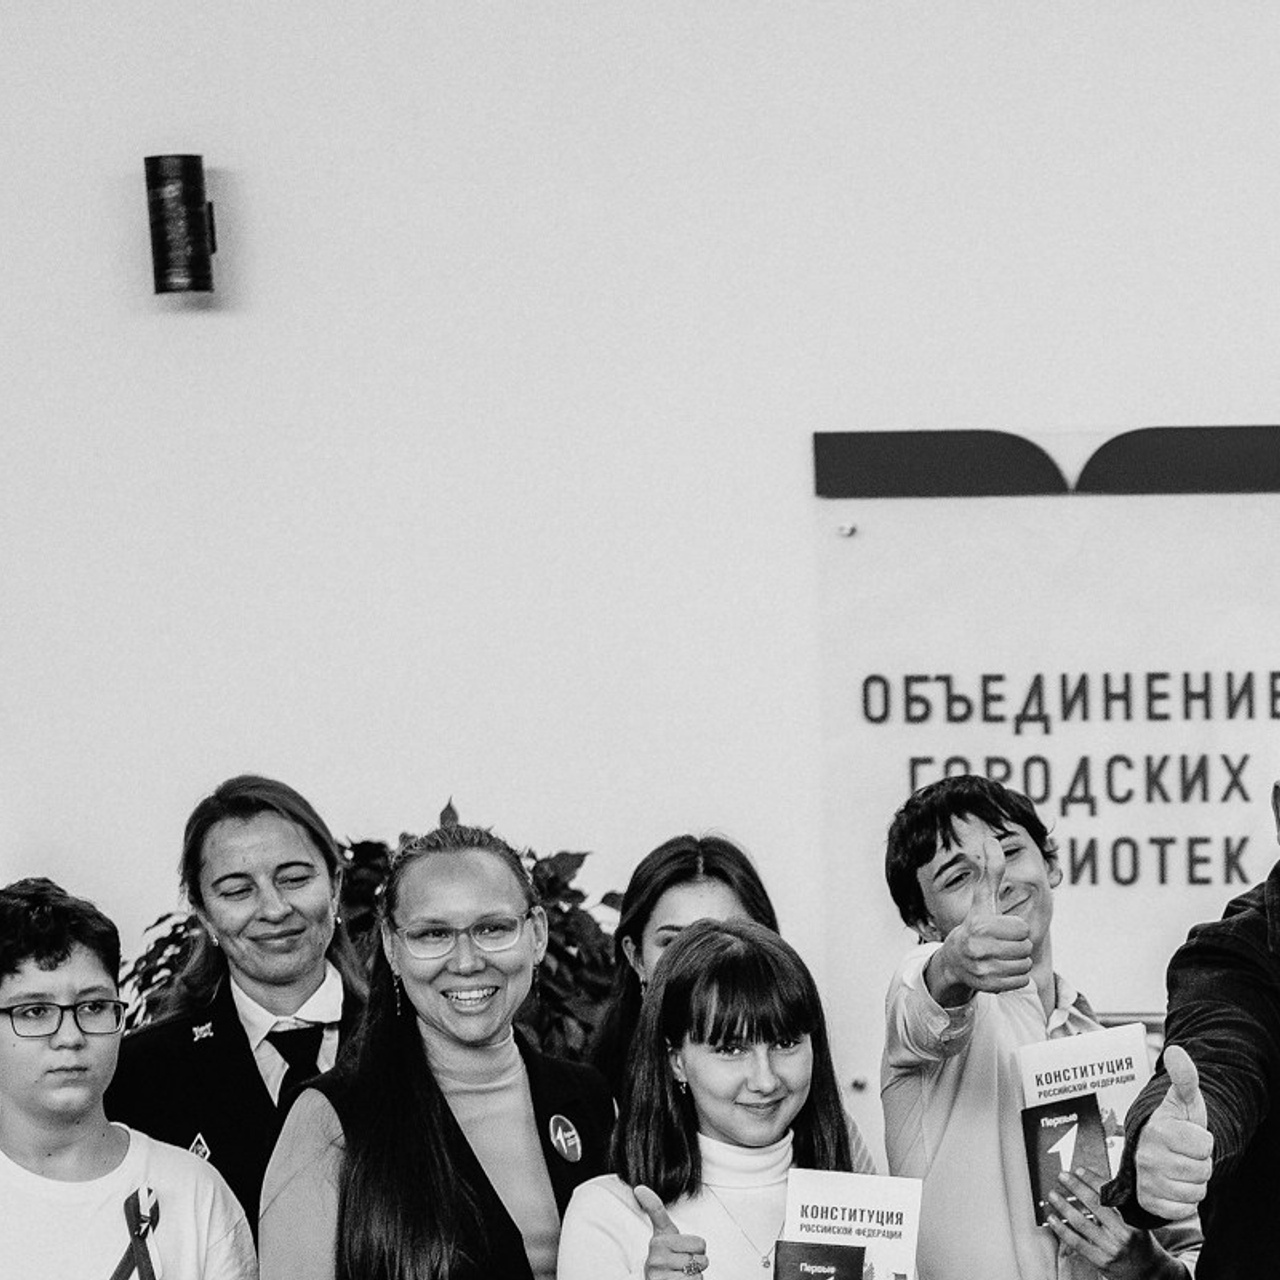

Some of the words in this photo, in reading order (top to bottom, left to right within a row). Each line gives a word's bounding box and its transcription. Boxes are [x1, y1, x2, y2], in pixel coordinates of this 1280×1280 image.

[1069, 835, 1251, 886] ИОТЕК
[1035, 1056, 1134, 1087] КОНСТИТУЦИЯ
[1038, 1081, 1088, 1098] РОССИЙСКОЙ
[799, 1204, 904, 1227] КОНСТИТУЦИЯ
[799, 1223, 853, 1236] РОССИЙСКОЙ
[854, 1228, 903, 1240] ФЕДЕРАЦИИ
[800, 1262, 836, 1275] Первые
